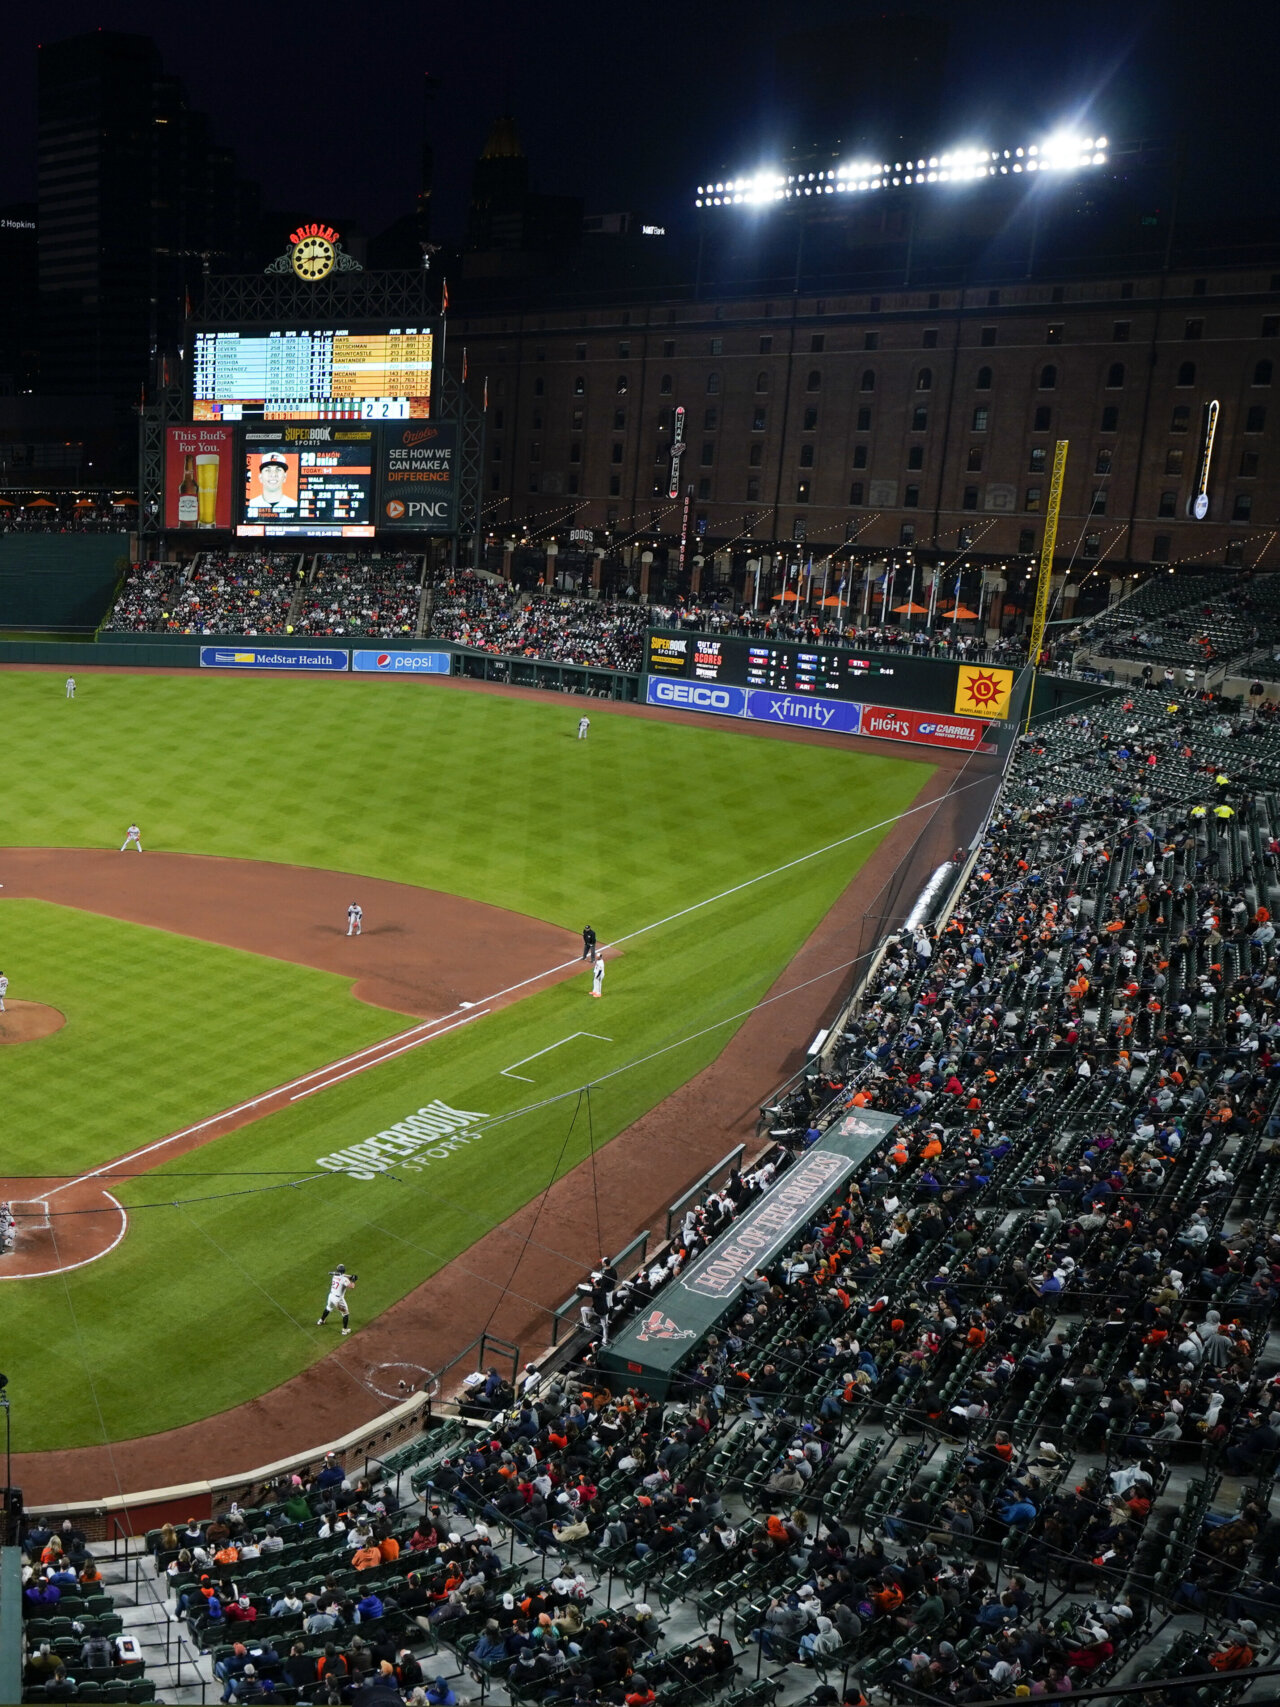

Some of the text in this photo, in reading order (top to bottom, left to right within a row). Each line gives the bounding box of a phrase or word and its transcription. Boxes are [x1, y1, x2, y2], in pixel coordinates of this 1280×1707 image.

[289, 223, 340, 244] ORIOLES
[366, 404, 373, 417] 2
[382, 403, 389, 417] 2
[400, 403, 403, 417] 1
[172, 430, 226, 441] This Bud's
[285, 427, 331, 441] SUPERBOOK
[402, 427, 438, 445] Orioles
[179, 442, 220, 452] For You.
[389, 449, 451, 458] SEE HOW WE
[389, 461, 450, 470] CAN MAKE A
[388, 472, 450, 481] DIFFERENCE
[408, 502, 448, 517] PNC
[570, 529, 594, 542] BOOGS
[651, 636, 688, 653] SUPERBOOK
[699, 647, 719, 655] TOWN
[257, 654, 332, 665] MedStar Health
[394, 655, 432, 669] pepsi
[694, 653, 722, 665] SCORES
[657, 683, 730, 708] GEICO
[769, 697, 835, 726] xfinity
[959, 707, 982, 715] MARYLAND
[870, 718, 909, 736] HIGH'S
[936, 724, 976, 736] CARROLL
[316, 1099, 490, 1180] SUPERBOOK
[402, 1130, 482, 1172] SPORTS
[695, 1155, 842, 1290] HOME OF THE ORIOLES
